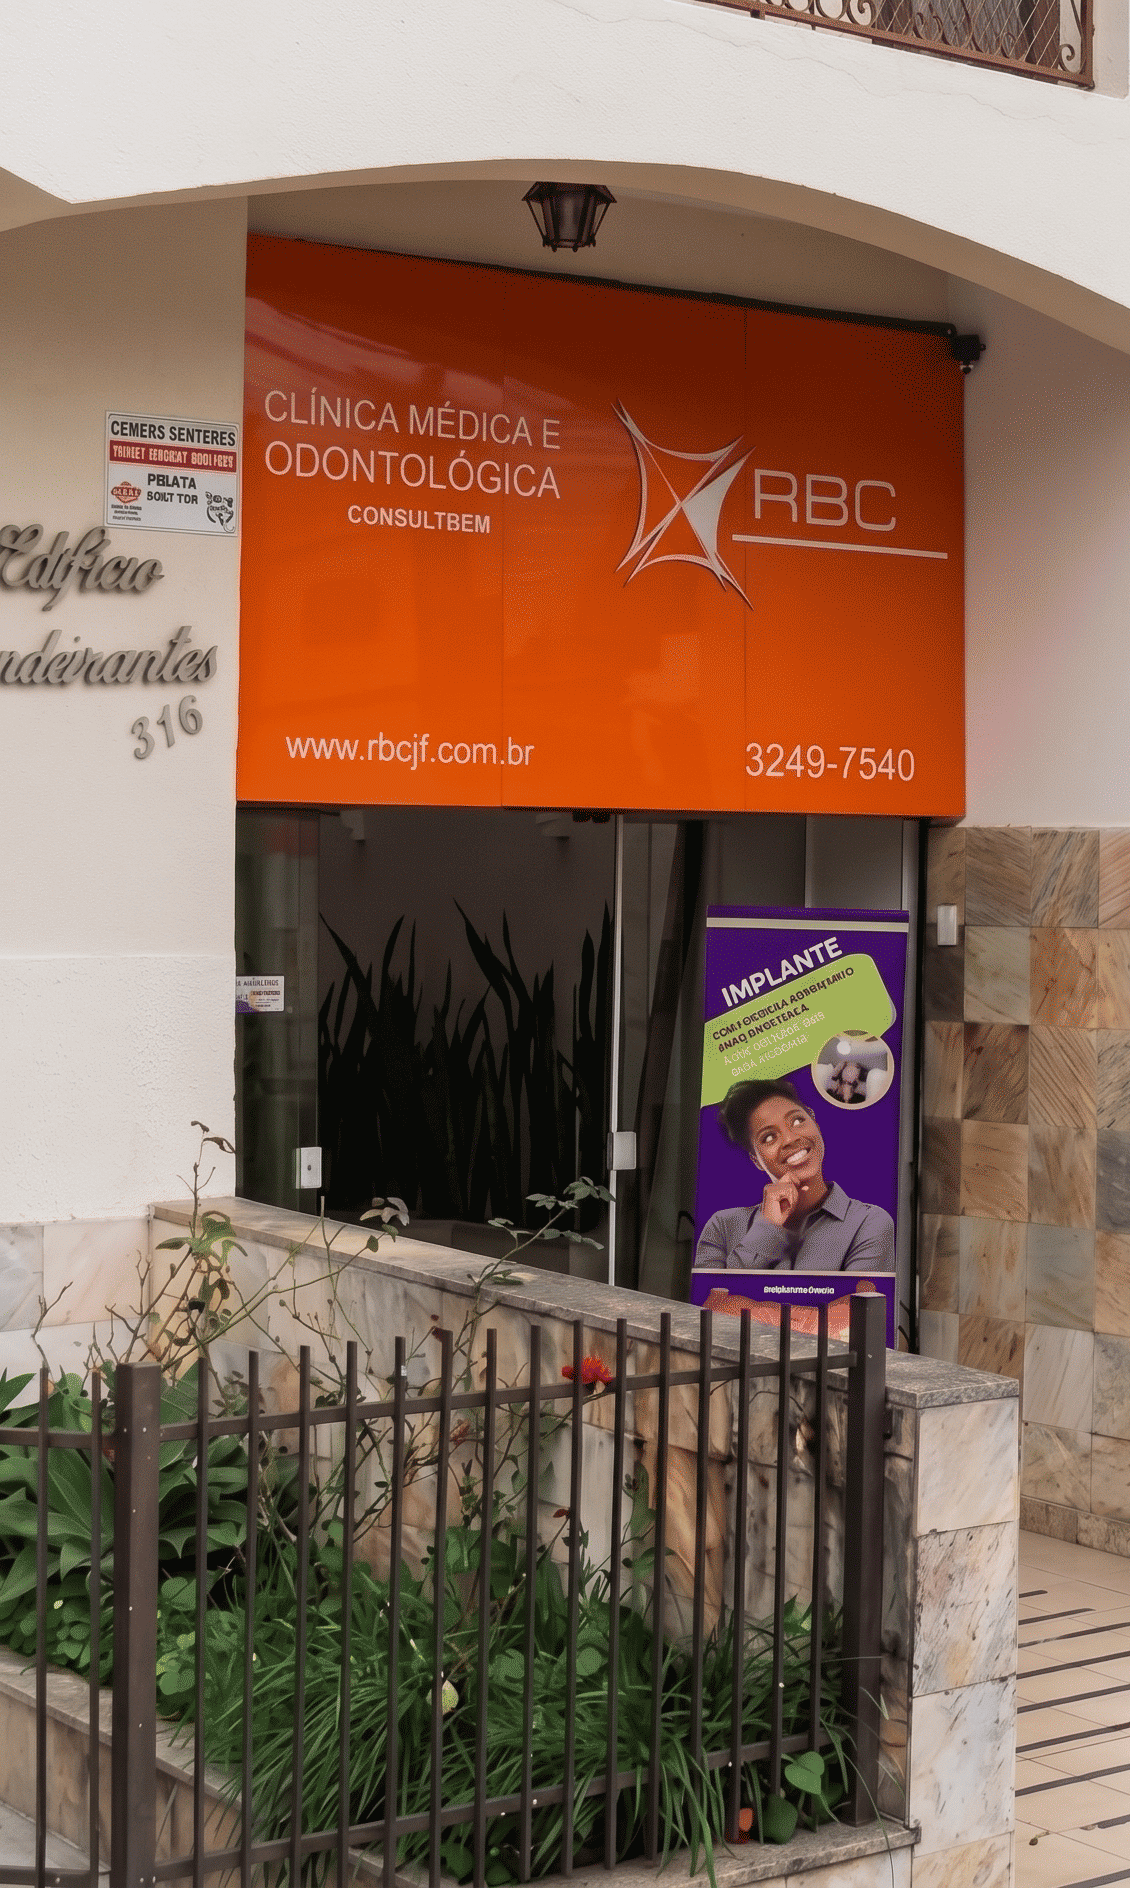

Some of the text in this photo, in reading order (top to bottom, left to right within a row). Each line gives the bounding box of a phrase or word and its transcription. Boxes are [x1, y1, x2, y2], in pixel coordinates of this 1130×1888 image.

[111, 420, 235, 447] CEMERS SENTERES
[265, 386, 560, 448] CLÍNICA MÉDICA E
[265, 440, 561, 499] ODONTOLÓGICA
[347, 504, 490, 534] CONSULTBEM
[753, 469, 896, 532] RBC
[131, 695, 204, 760] 316
[286, 731, 534, 770] www.rbcjf.com.br
[745, 742, 915, 782] 3249-7540
[721, 937, 843, 1007] IMPLANTE
